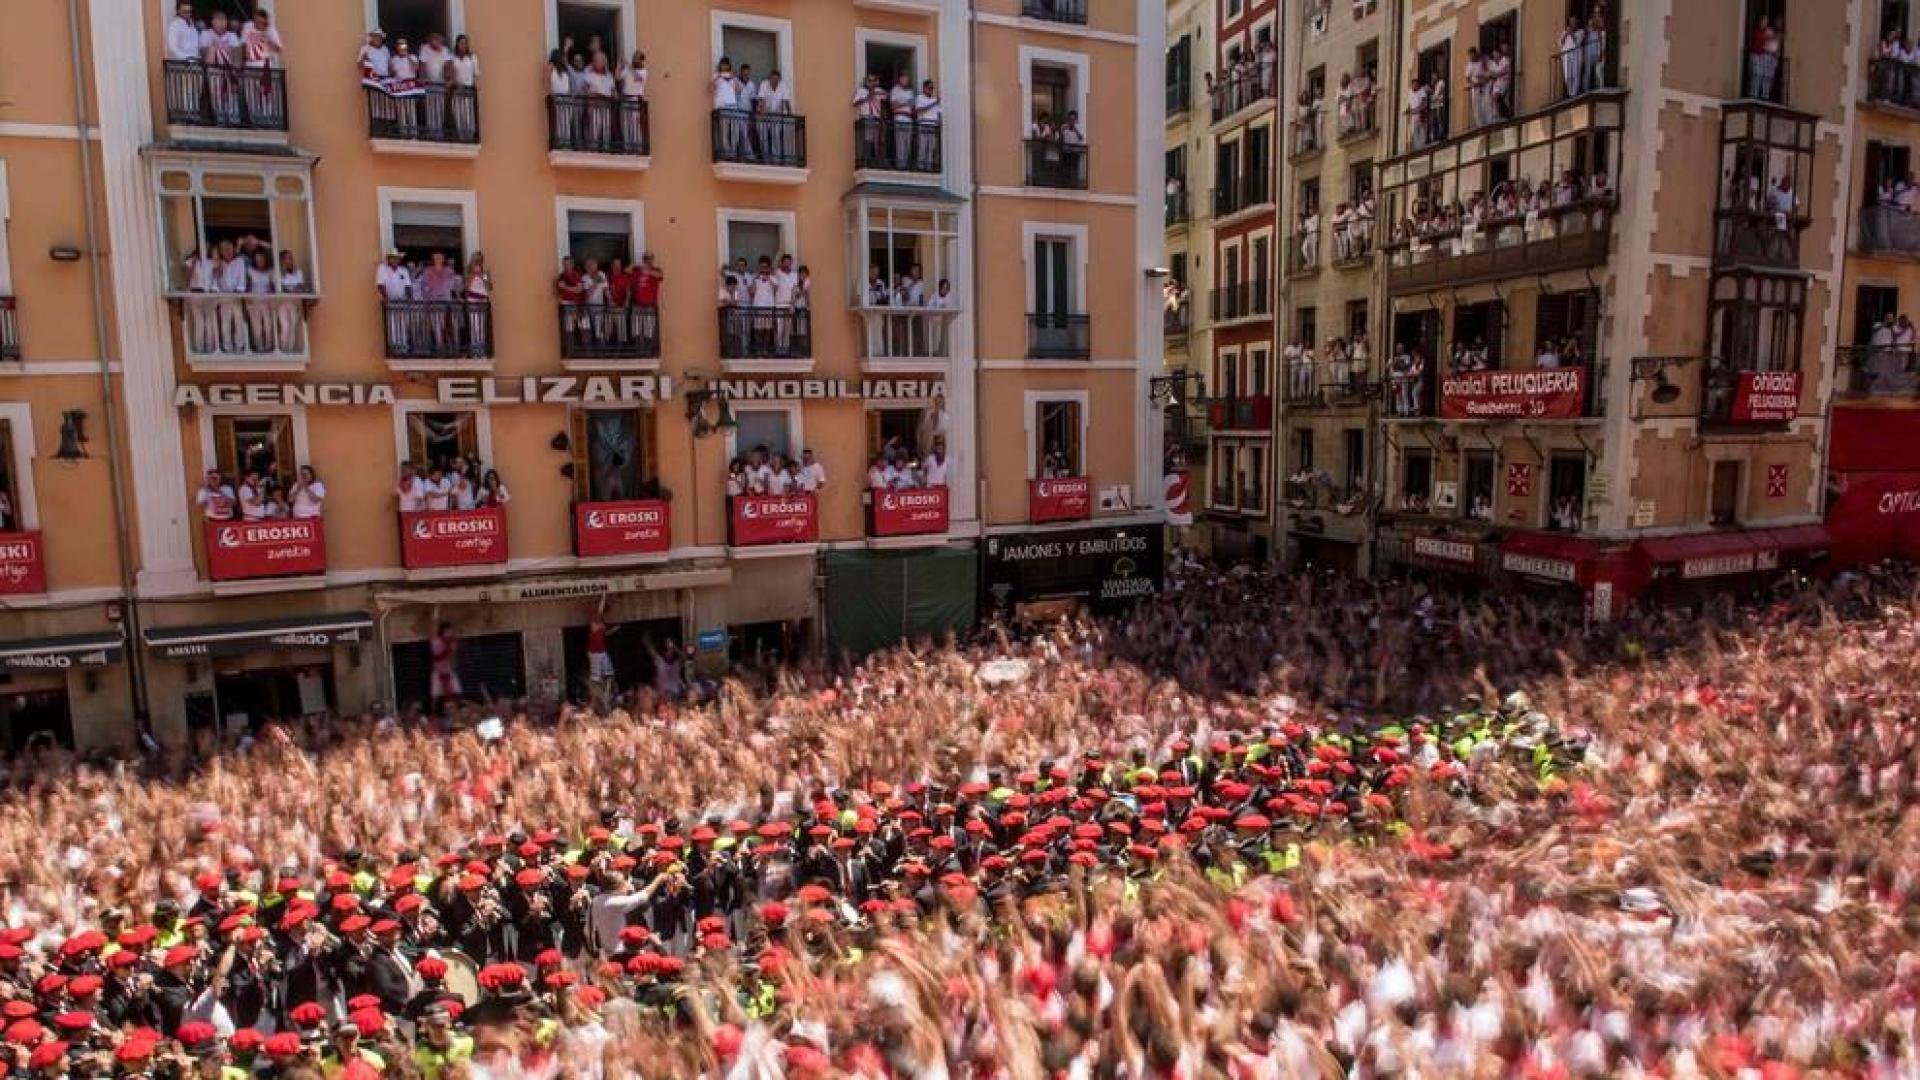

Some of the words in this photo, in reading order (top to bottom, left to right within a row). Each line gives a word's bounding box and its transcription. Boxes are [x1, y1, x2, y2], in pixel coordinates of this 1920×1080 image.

[175, 384, 395, 405] AGENCIA
[437, 375, 672, 403] ELIZARI
[708, 379, 946, 399] INMOBILIARIA
[1053, 482, 1087, 494] EROSKI
[900, 494, 941, 507] EROSKI
[608, 511, 658, 525] EROSKI
[247, 526, 309, 542] EROSKI
[437, 519, 494, 534] EROSKI
[1001, 542, 1062, 561] JAMONES
[1066, 542, 1076, 557] Y
[1079, 536, 1148, 555] EMBUTIDOS
